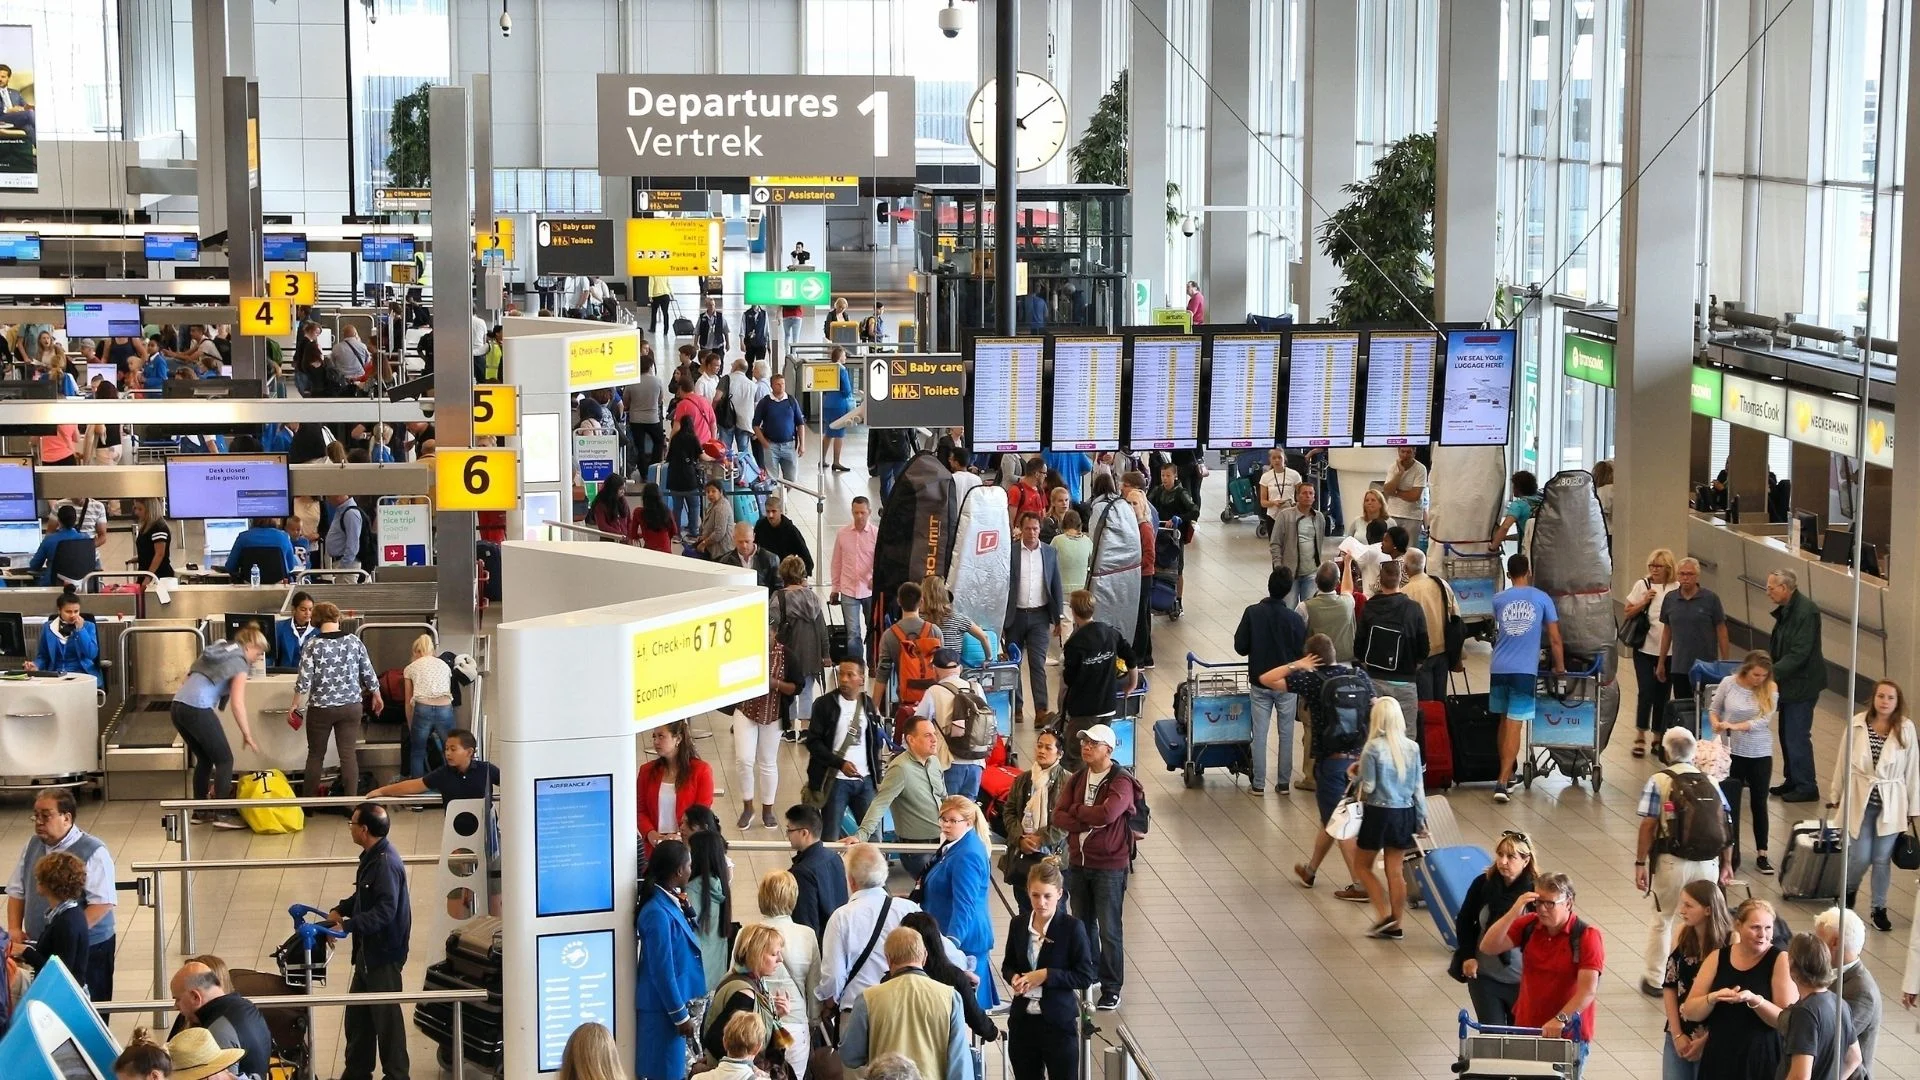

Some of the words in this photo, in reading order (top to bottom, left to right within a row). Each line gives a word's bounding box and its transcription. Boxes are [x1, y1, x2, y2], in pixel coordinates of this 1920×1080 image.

[628, 86, 838, 125] Departures
[857, 91, 888, 157] 1
[626, 125, 764, 157] Vertrek
[788, 190, 836, 200] Assistance
[284, 274, 299, 296] 3
[255, 302, 274, 326] 4
[600, 342, 606, 356] 4
[608, 342, 614, 355] 5
[570, 370, 592, 378] Economy
[910, 362, 936, 374] Baby
[940, 364, 962, 372] care
[923, 386, 960, 396] Toilets
[474, 390, 494, 422] 5
[1740, 394, 1763, 417] Thomas
[1764, 402, 1780, 422] Cook
[1810, 416, 1849, 436] NECKERMANN
[464, 454, 490, 494] 6
[984, 535, 994, 546] T
[652, 635, 691, 656] Check-in
[694, 625, 702, 652] 6
[709, 622, 717, 648] 7
[724, 618, 732, 643] 8
[636, 682, 678, 704] Economy
